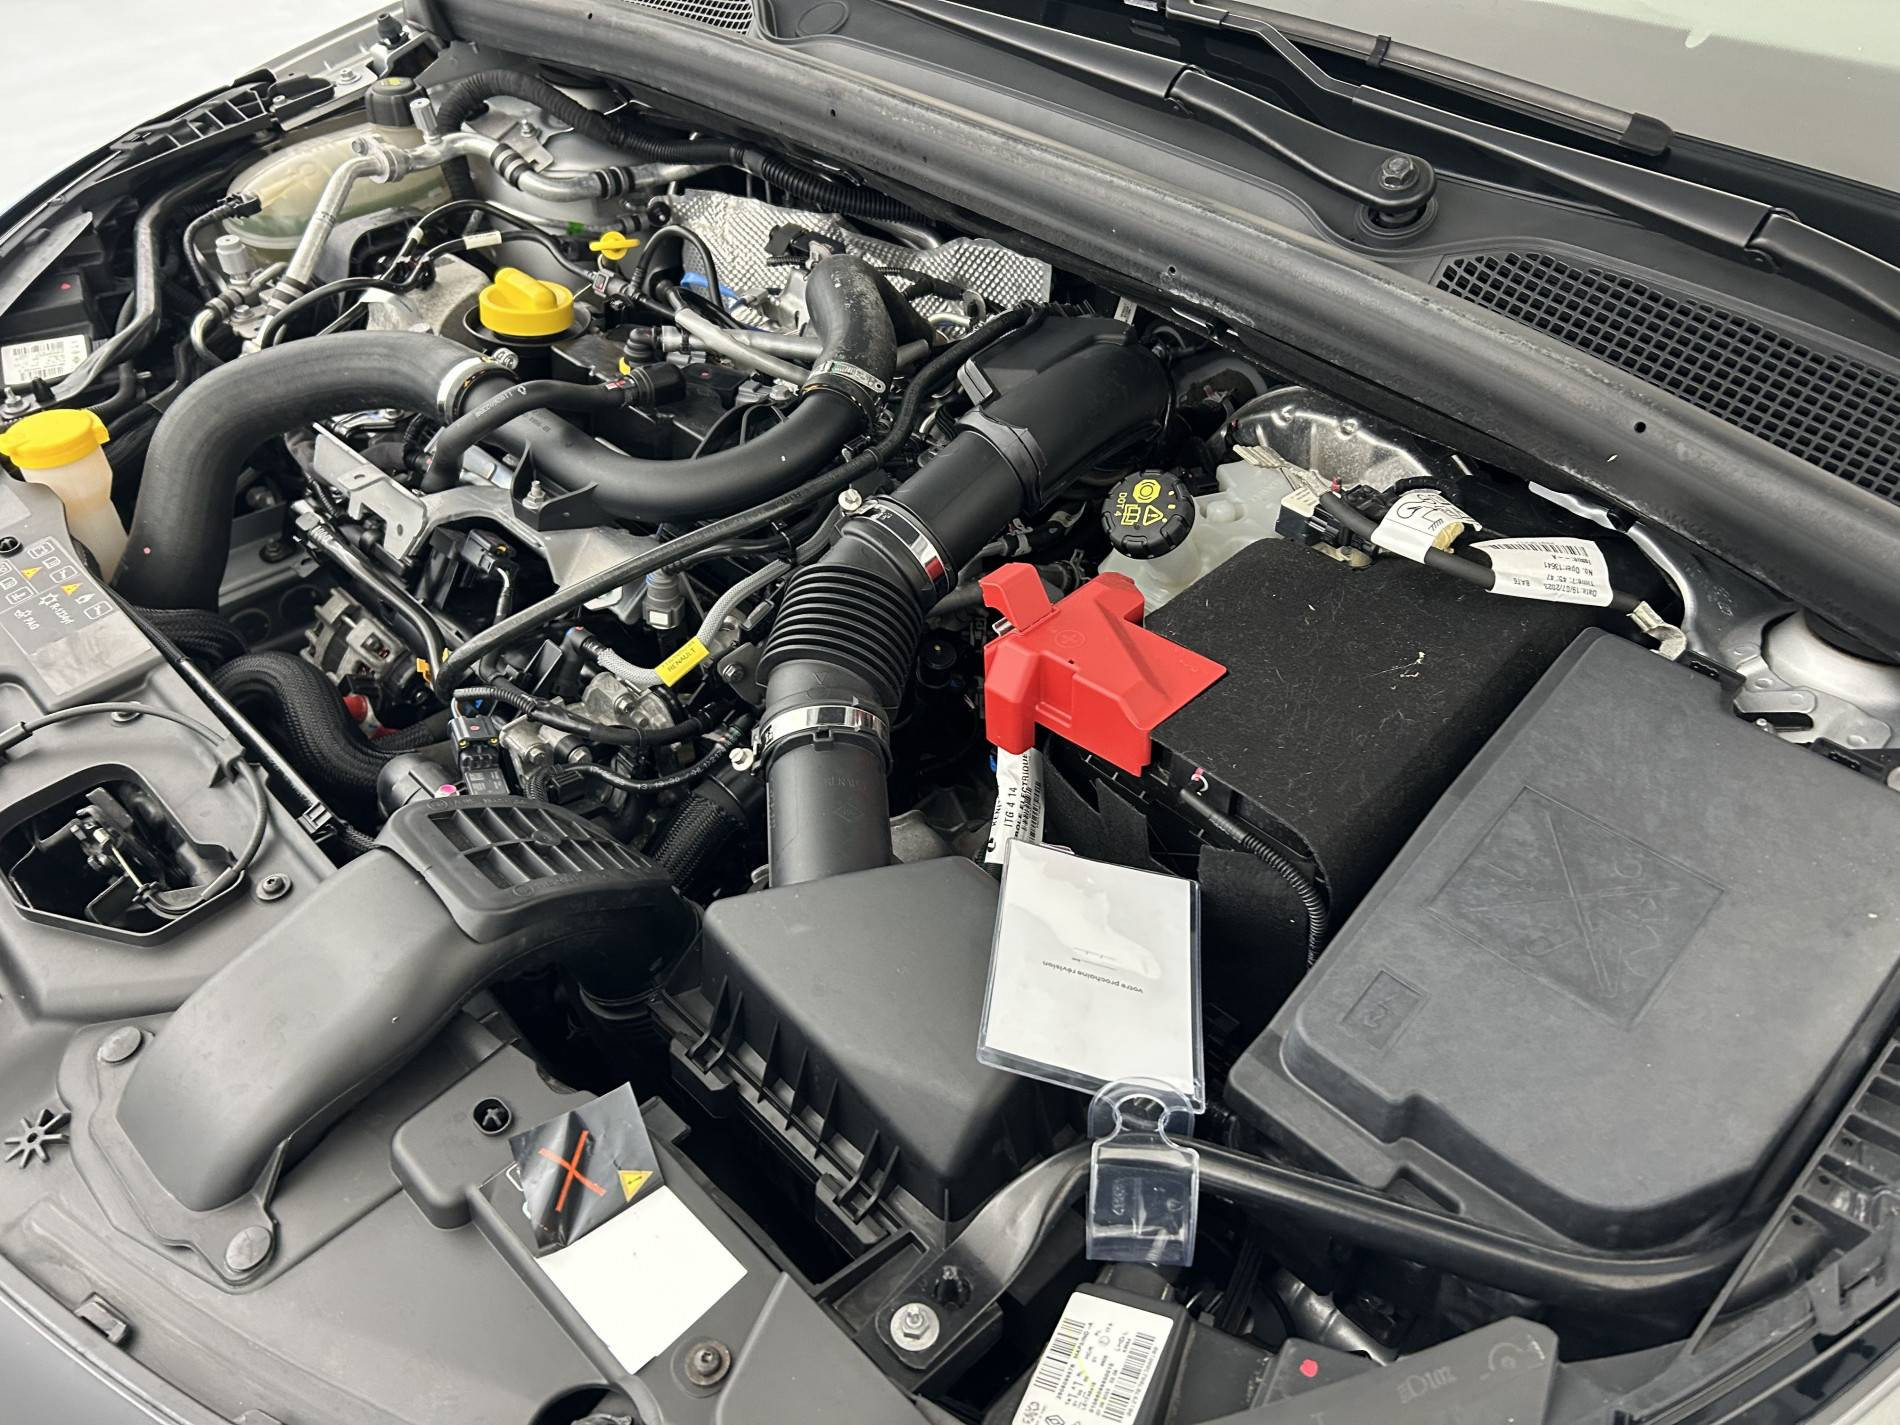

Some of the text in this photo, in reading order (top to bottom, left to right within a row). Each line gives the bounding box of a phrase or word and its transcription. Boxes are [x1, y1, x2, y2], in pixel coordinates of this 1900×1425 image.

[1116, 492, 1128, 509] DOT
[667, 647, 697, 672] RENAULT
[1008, 787, 1017, 796] 14
[1077, 970, 1120, 986] prochaine
[1121, 983, 1143, 993] votre
